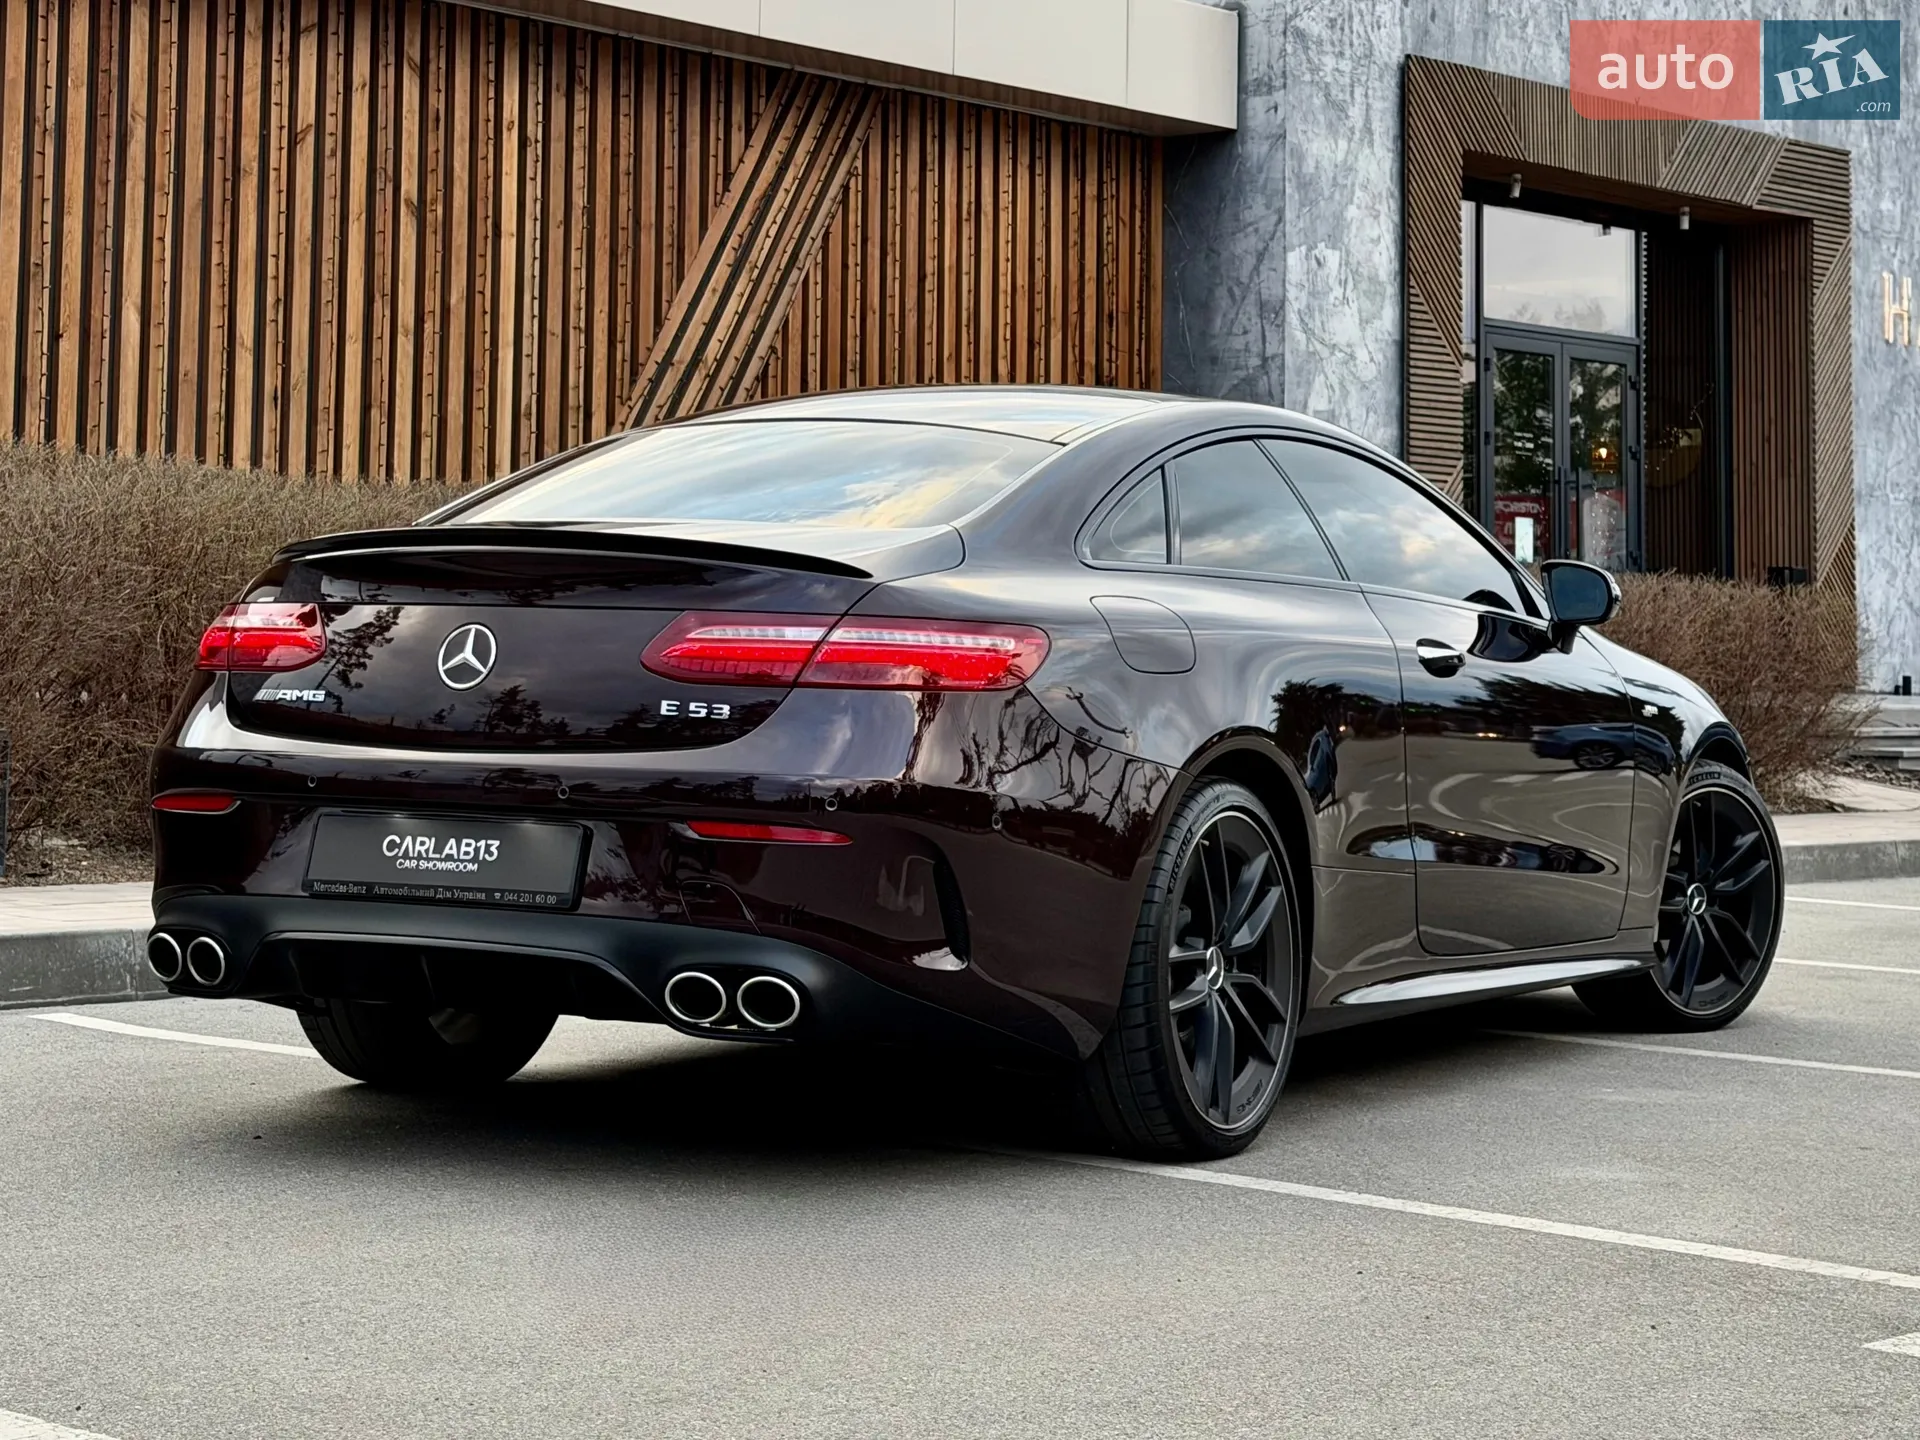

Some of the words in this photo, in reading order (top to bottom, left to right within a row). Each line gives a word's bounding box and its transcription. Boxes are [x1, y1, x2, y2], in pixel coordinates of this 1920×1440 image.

[1882, 270, 1920, 346] H
[660, 699, 681, 716] E
[688, 702, 731, 719] 53
[382, 834, 500, 862] CARLAB13
[396, 858, 417, 869] CAR
[418, 859, 478, 872] SHOWROOM
[313, 881, 367, 894] Mercedes-Benz
[436, 887, 452, 900] Дім
[453, 888, 486, 901] Україна
[504, 892, 517, 902] 044
[519, 892, 533, 903] 201
[535, 893, 546, 904] 60
[547, 894, 557, 905] 00
